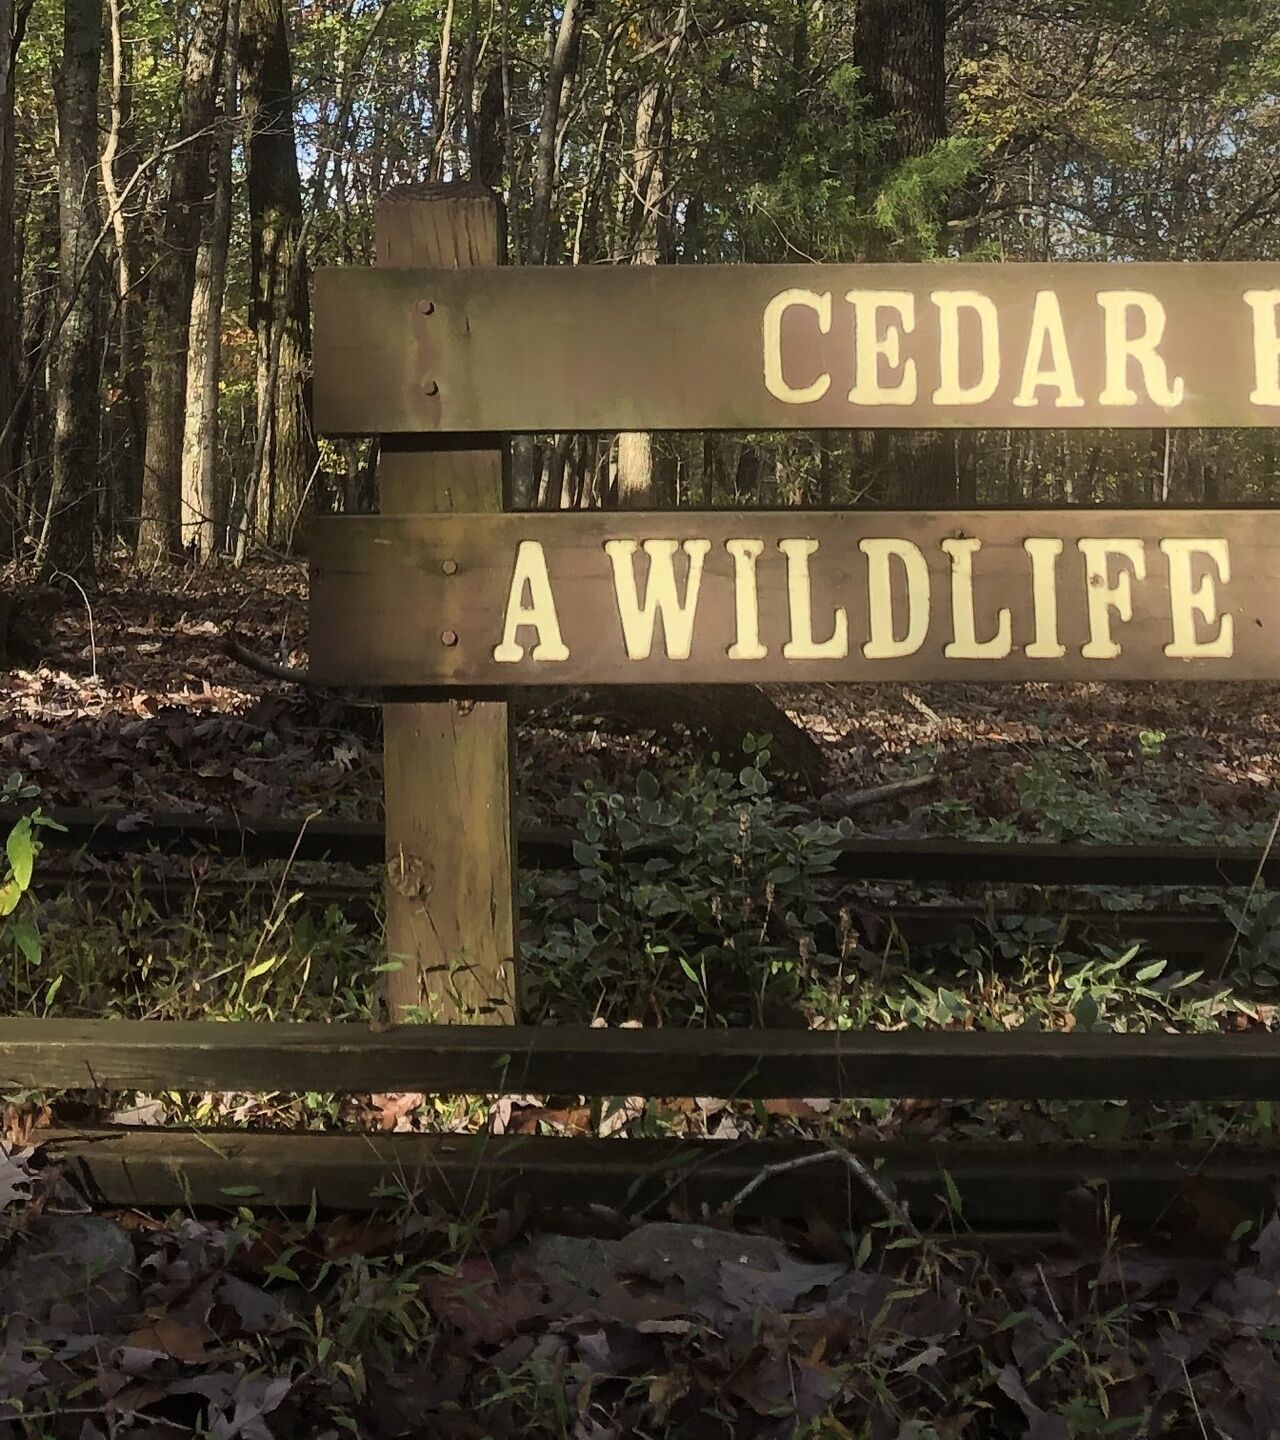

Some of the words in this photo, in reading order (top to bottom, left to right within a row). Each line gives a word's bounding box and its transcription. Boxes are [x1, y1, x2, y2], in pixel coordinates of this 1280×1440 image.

[761, 287, 1184, 408] CEDAR
[493, 539, 570, 663] A
[605, 538, 1234, 661] WILDLIFE
